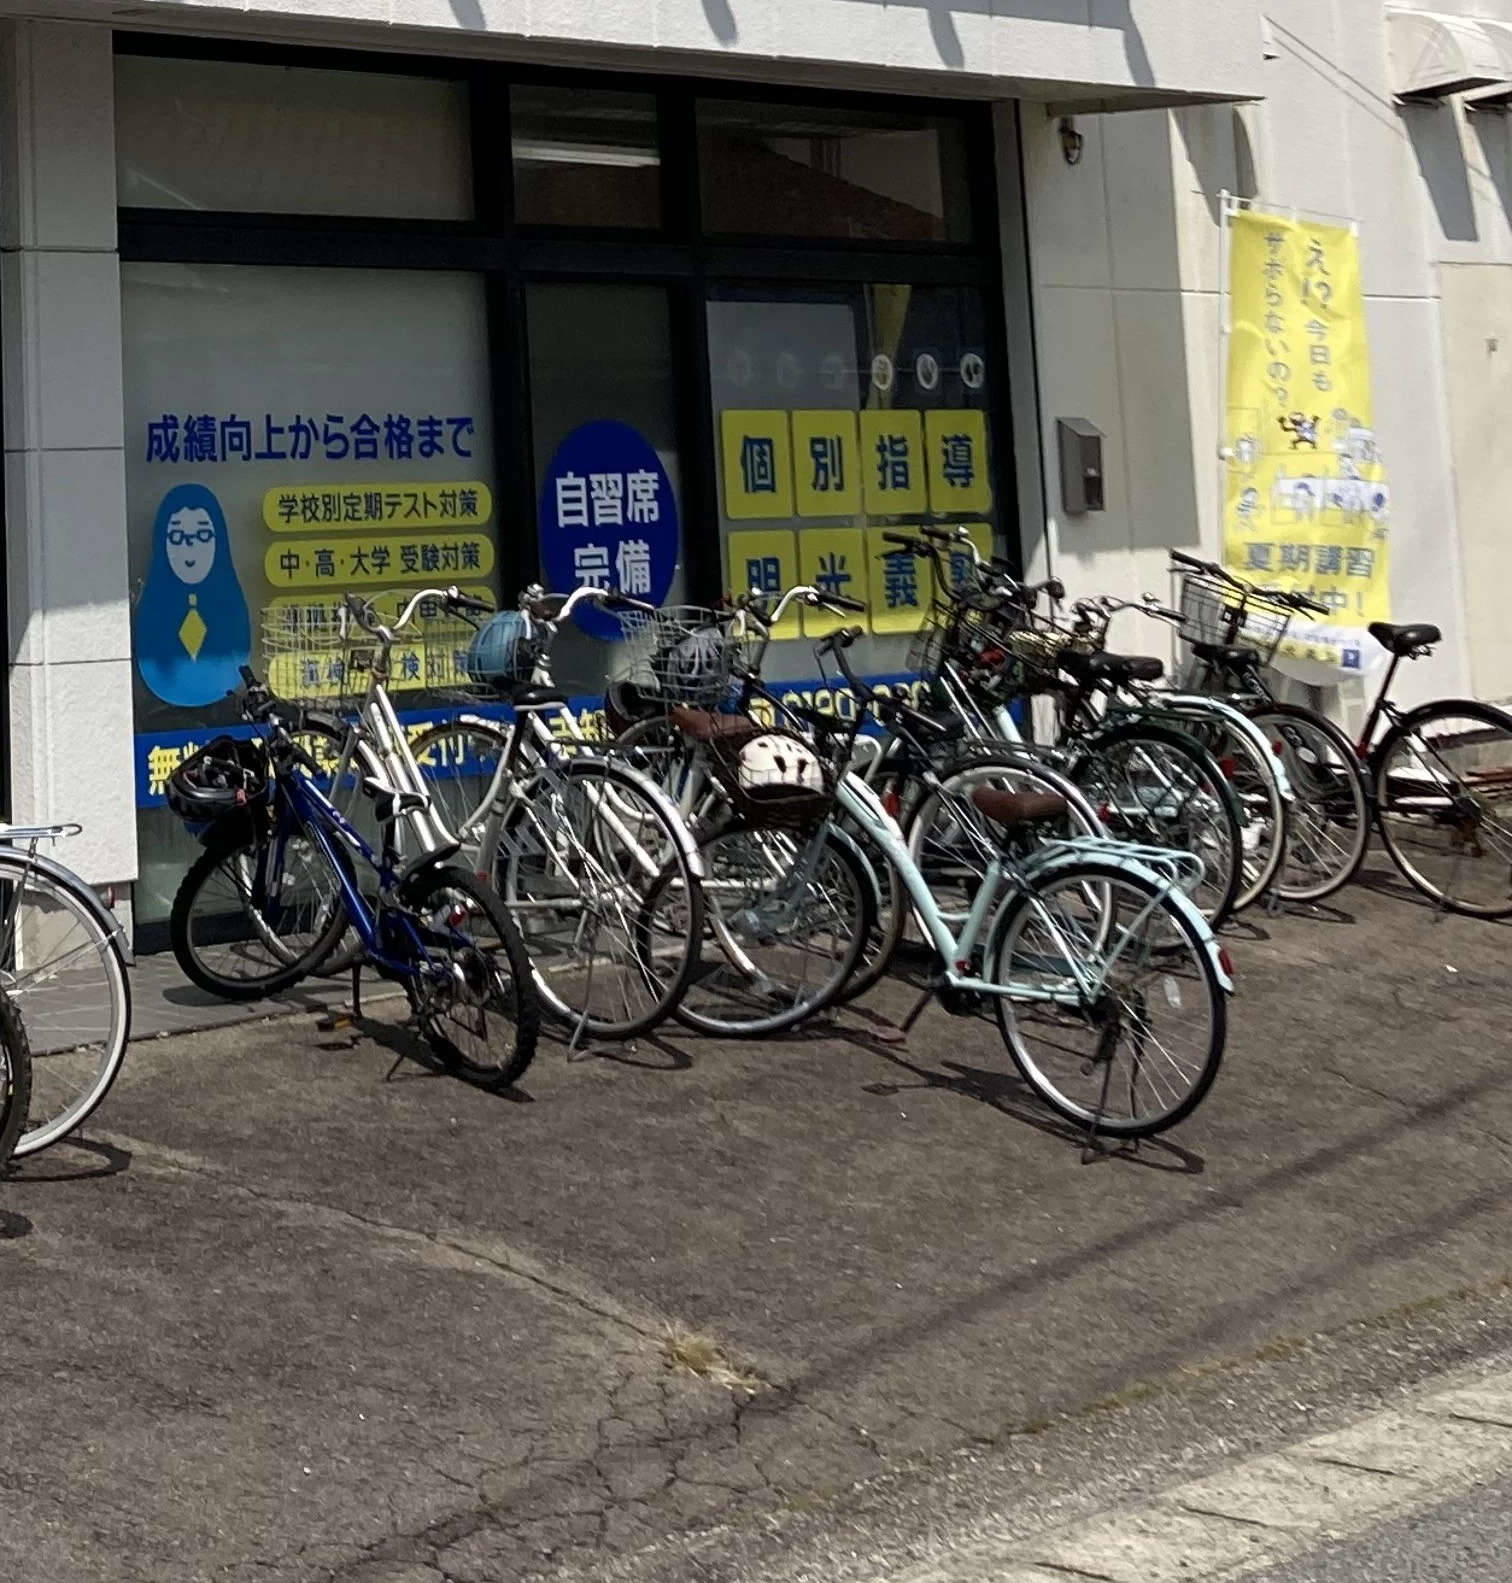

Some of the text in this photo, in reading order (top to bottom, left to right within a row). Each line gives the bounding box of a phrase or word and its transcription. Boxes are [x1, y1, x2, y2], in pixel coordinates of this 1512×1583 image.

[146, 413, 476, 464] 成績向上から合格まで
[739, 434, 976, 494] 個別指導
[278, 489, 479, 524] 学校別定期テスト対策
[556, 469, 660, 528] 自習席
[574, 539, 652, 596] 完備
[1243, 541, 1376, 578] 夏期講習
